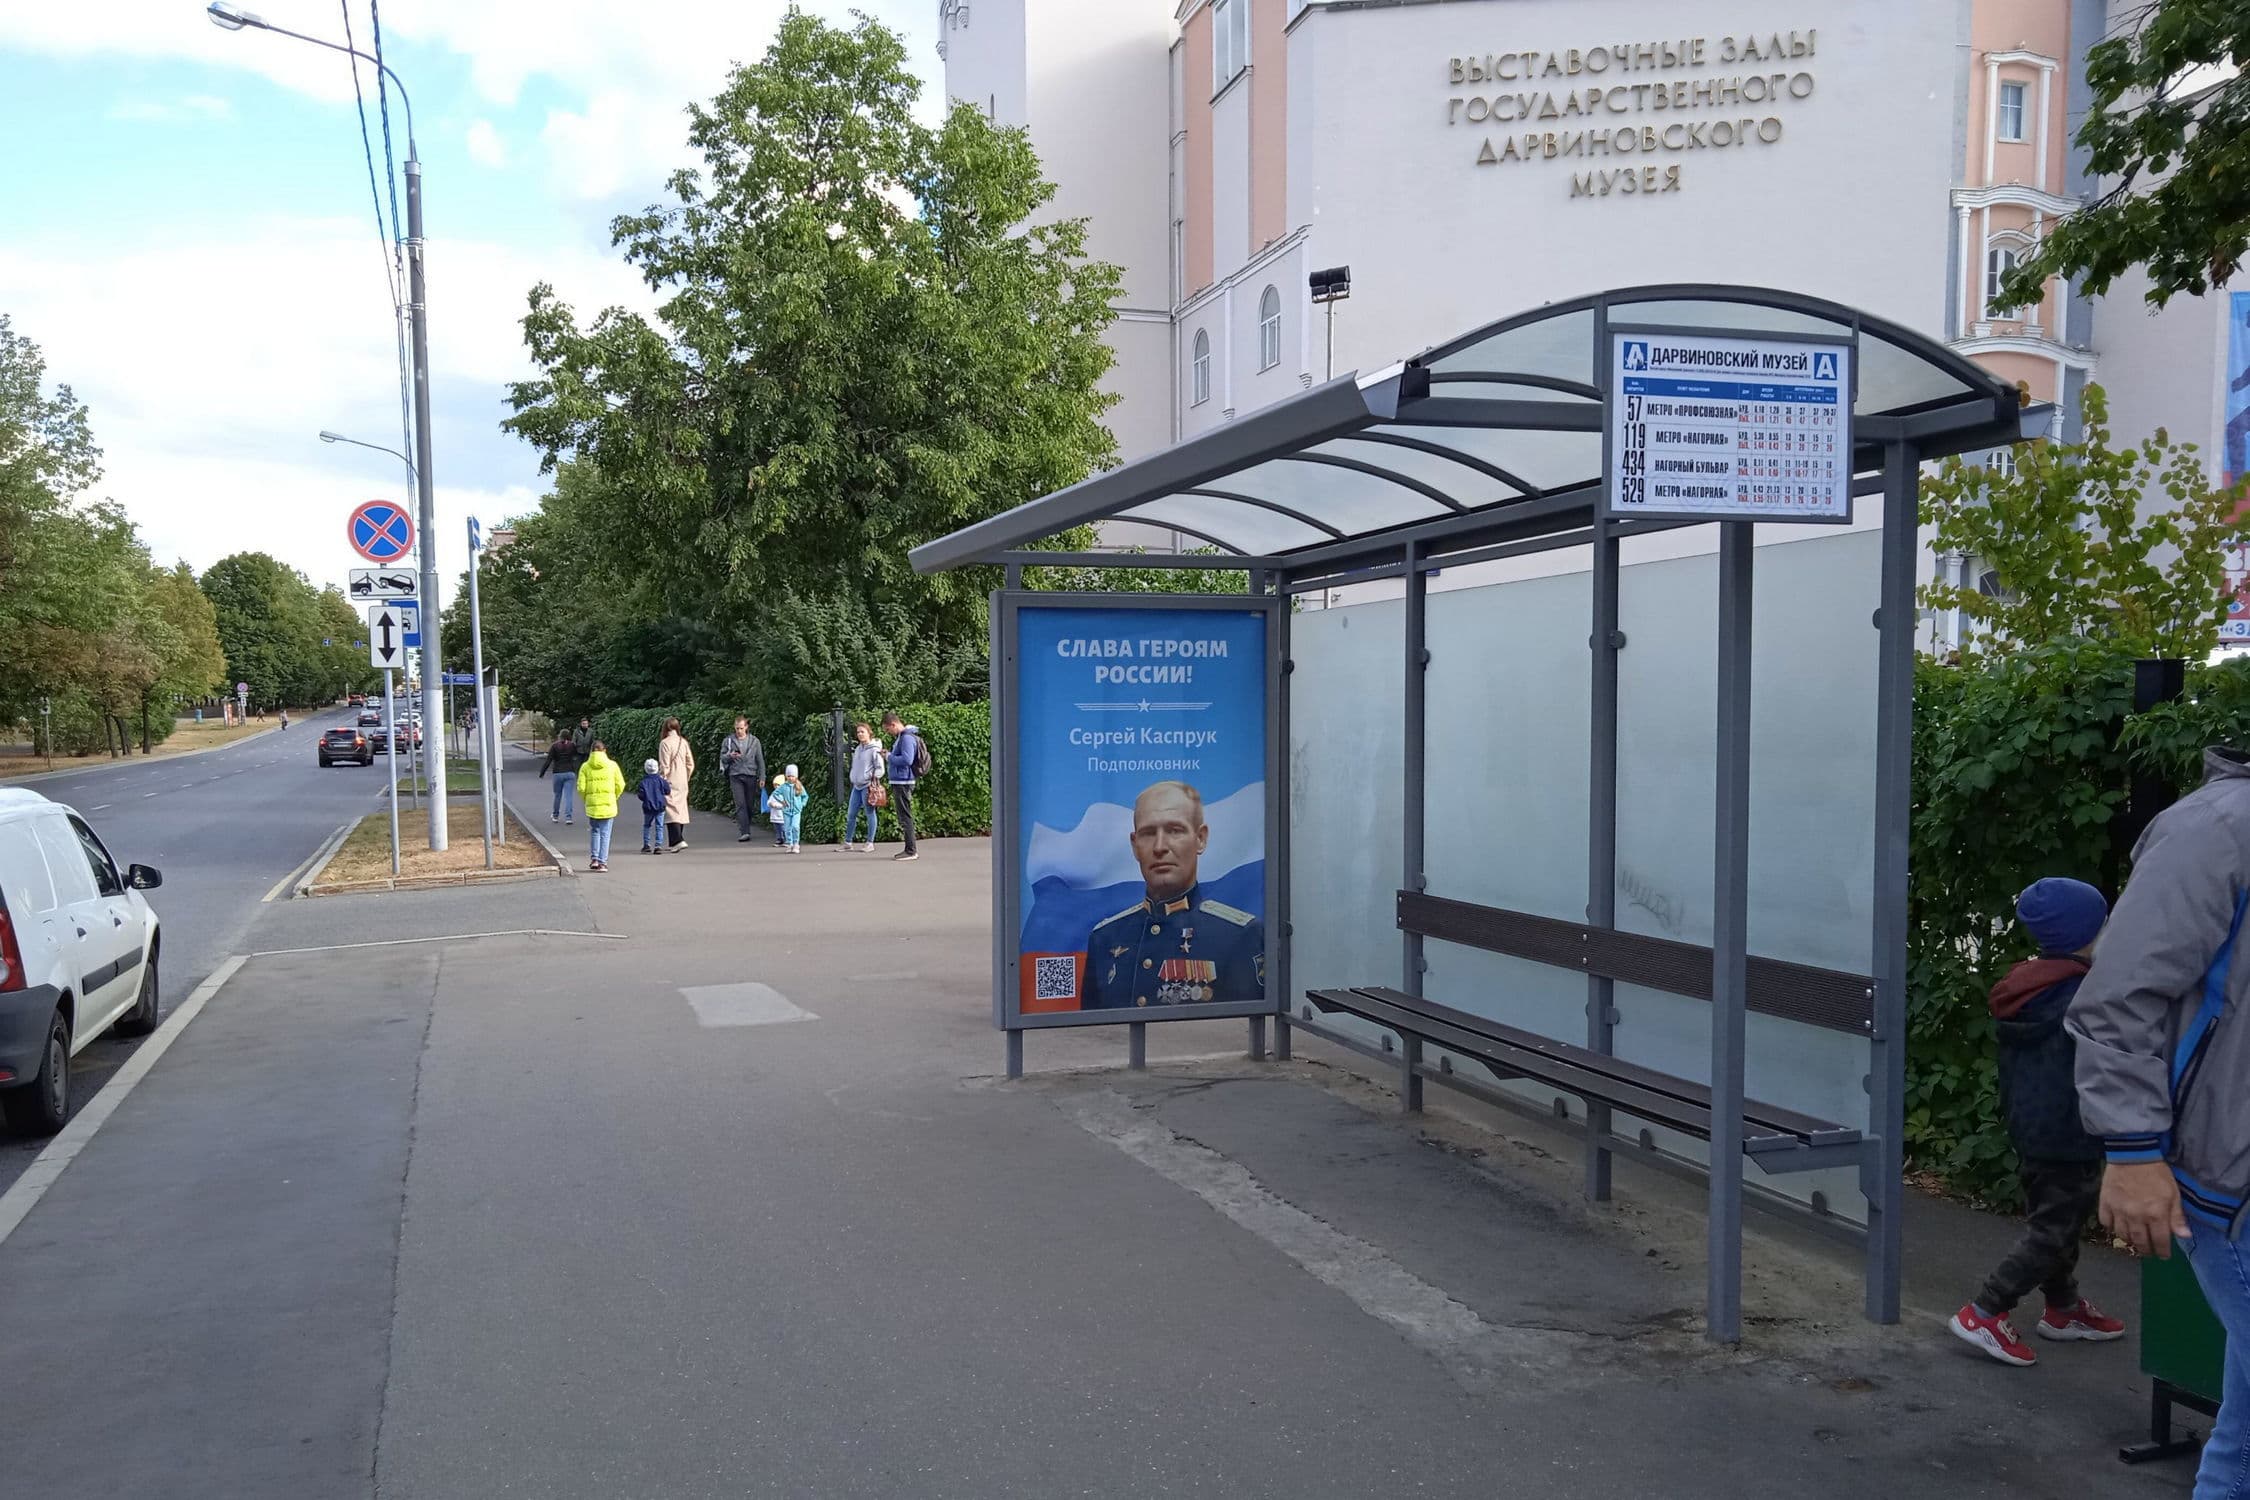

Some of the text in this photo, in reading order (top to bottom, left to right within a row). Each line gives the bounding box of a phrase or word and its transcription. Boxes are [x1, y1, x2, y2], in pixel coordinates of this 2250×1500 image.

[1449, 28, 1817, 84] ВЫСТАВОЧНЫЕ ЗАЛЫ
[1449, 72, 1815, 124] ГОСУДАРСТВЕННОГО
[1477, 116, 1783, 165] ДАРВИНОВСКОГО
[1570, 163, 1681, 198] МУЗЕЯ
[1651, 347, 1759, 368] ДАРВИНОВСКИЙ
[1762, 352, 1808, 371] МУЗЕЙ
[1815, 354, 1836, 379] А
[1627, 395, 1642, 421] 57
[1647, 403, 1673, 416] МЕТРО
[1623, 422, 1729, 449] 119 МЕТРО «НАГОРНАЯ»
[1622, 450, 1729, 476] 434 НАГОРНЫЙ БУЛЬВАР
[1622, 477, 1728, 503] 529 МЕТРО «НАГОРНАЯ»
[1057, 639, 1228, 658] СЛАВА ГЕРОЯМ
[1095, 666, 1193, 684] РОССИИ!
[1069, 727, 1217, 749] Сергей Каспрук
[1088, 757, 1200, 773] Подполковник
